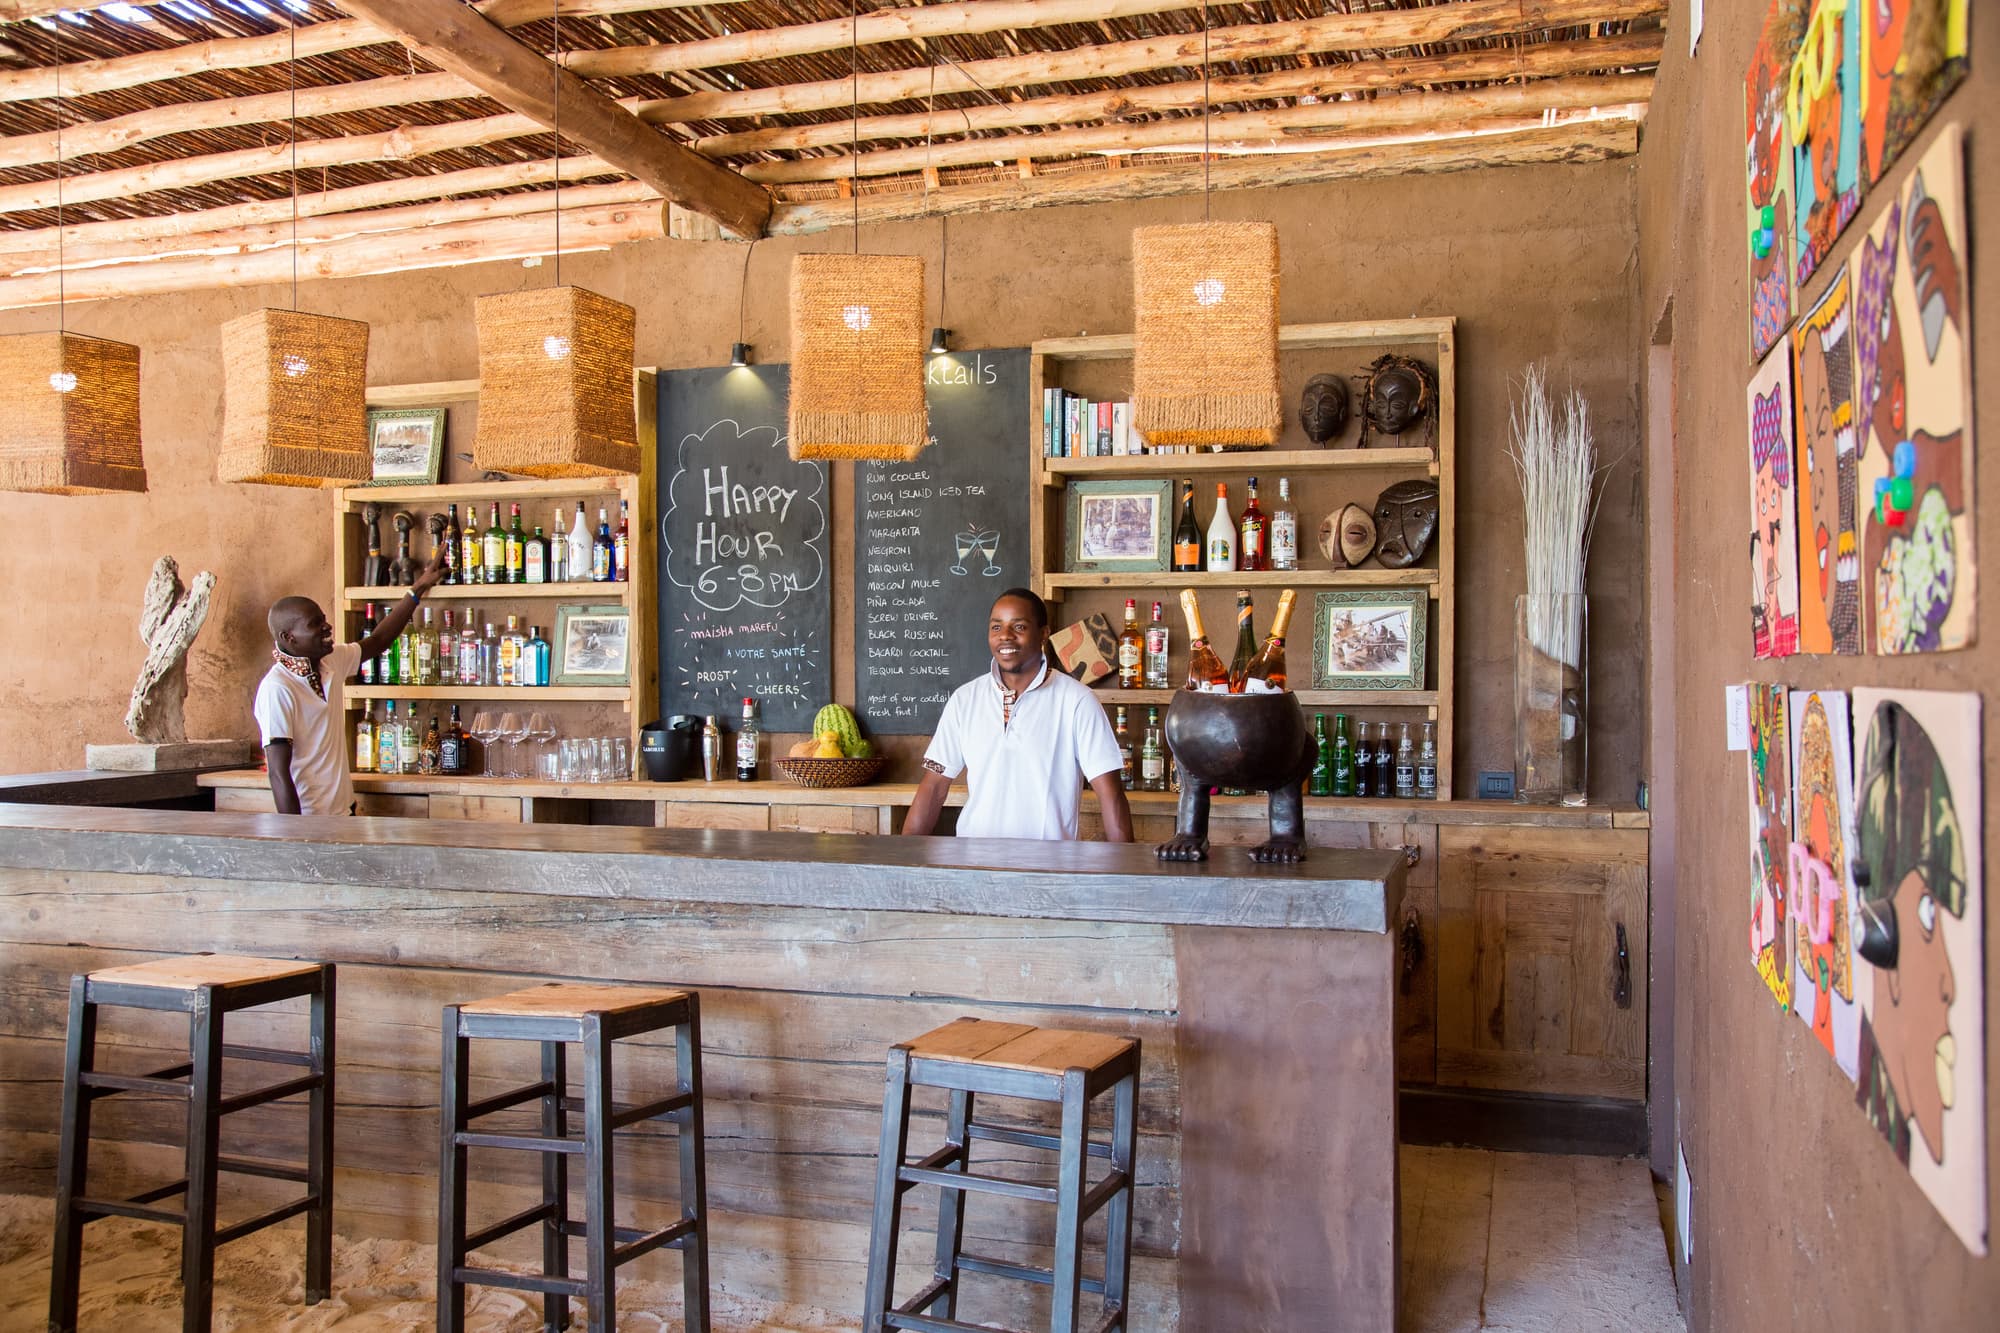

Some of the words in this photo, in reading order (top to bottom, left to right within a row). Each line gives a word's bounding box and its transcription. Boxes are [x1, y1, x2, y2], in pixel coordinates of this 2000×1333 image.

[923, 353, 998, 385] ktails
[866, 473, 886, 484] RUM
[890, 471, 930, 482] COOLER
[703, 465, 798, 523] HAPPY
[867, 491, 894, 504] LONG
[900, 488, 932, 499] ISLAND
[939, 486, 962, 497] ICED
[965, 485, 986, 496] TEA
[866, 508, 922, 520] AMERICANO
[868, 526, 921, 541] MARGARITA
[695, 521, 784, 565] HOUR
[867, 545, 911, 558] NEGRONI
[868, 562, 914, 574] DAIQUIRI
[698, 564, 764, 593] 6-8
[769, 572, 799, 593] PM
[867, 578, 905, 591] MOSCOW
[910, 579, 941, 589] MULE
[866, 595, 888, 608] PIÑA
[891, 597, 926, 607] COLADA
[867, 613, 898, 624] SCREW
[903, 611, 938, 622] DRIVER
[868, 629, 897, 640] BLACK
[904, 629, 944, 640] RUSSIAN
[734, 649, 765, 660] VOTRE
[771, 643, 806, 660] SANTÉ
[868, 646, 903, 659] BACARDI
[909, 648, 950, 658] COCKTAIL
[696, 670, 731, 682] PROST
[867, 666, 904, 676] TEQUILA
[909, 666, 950, 676] SUNRISE
[755, 684, 800, 696] CHEERS
[889, 692, 900, 704] of
[919, 690, 951, 704] cocktail
